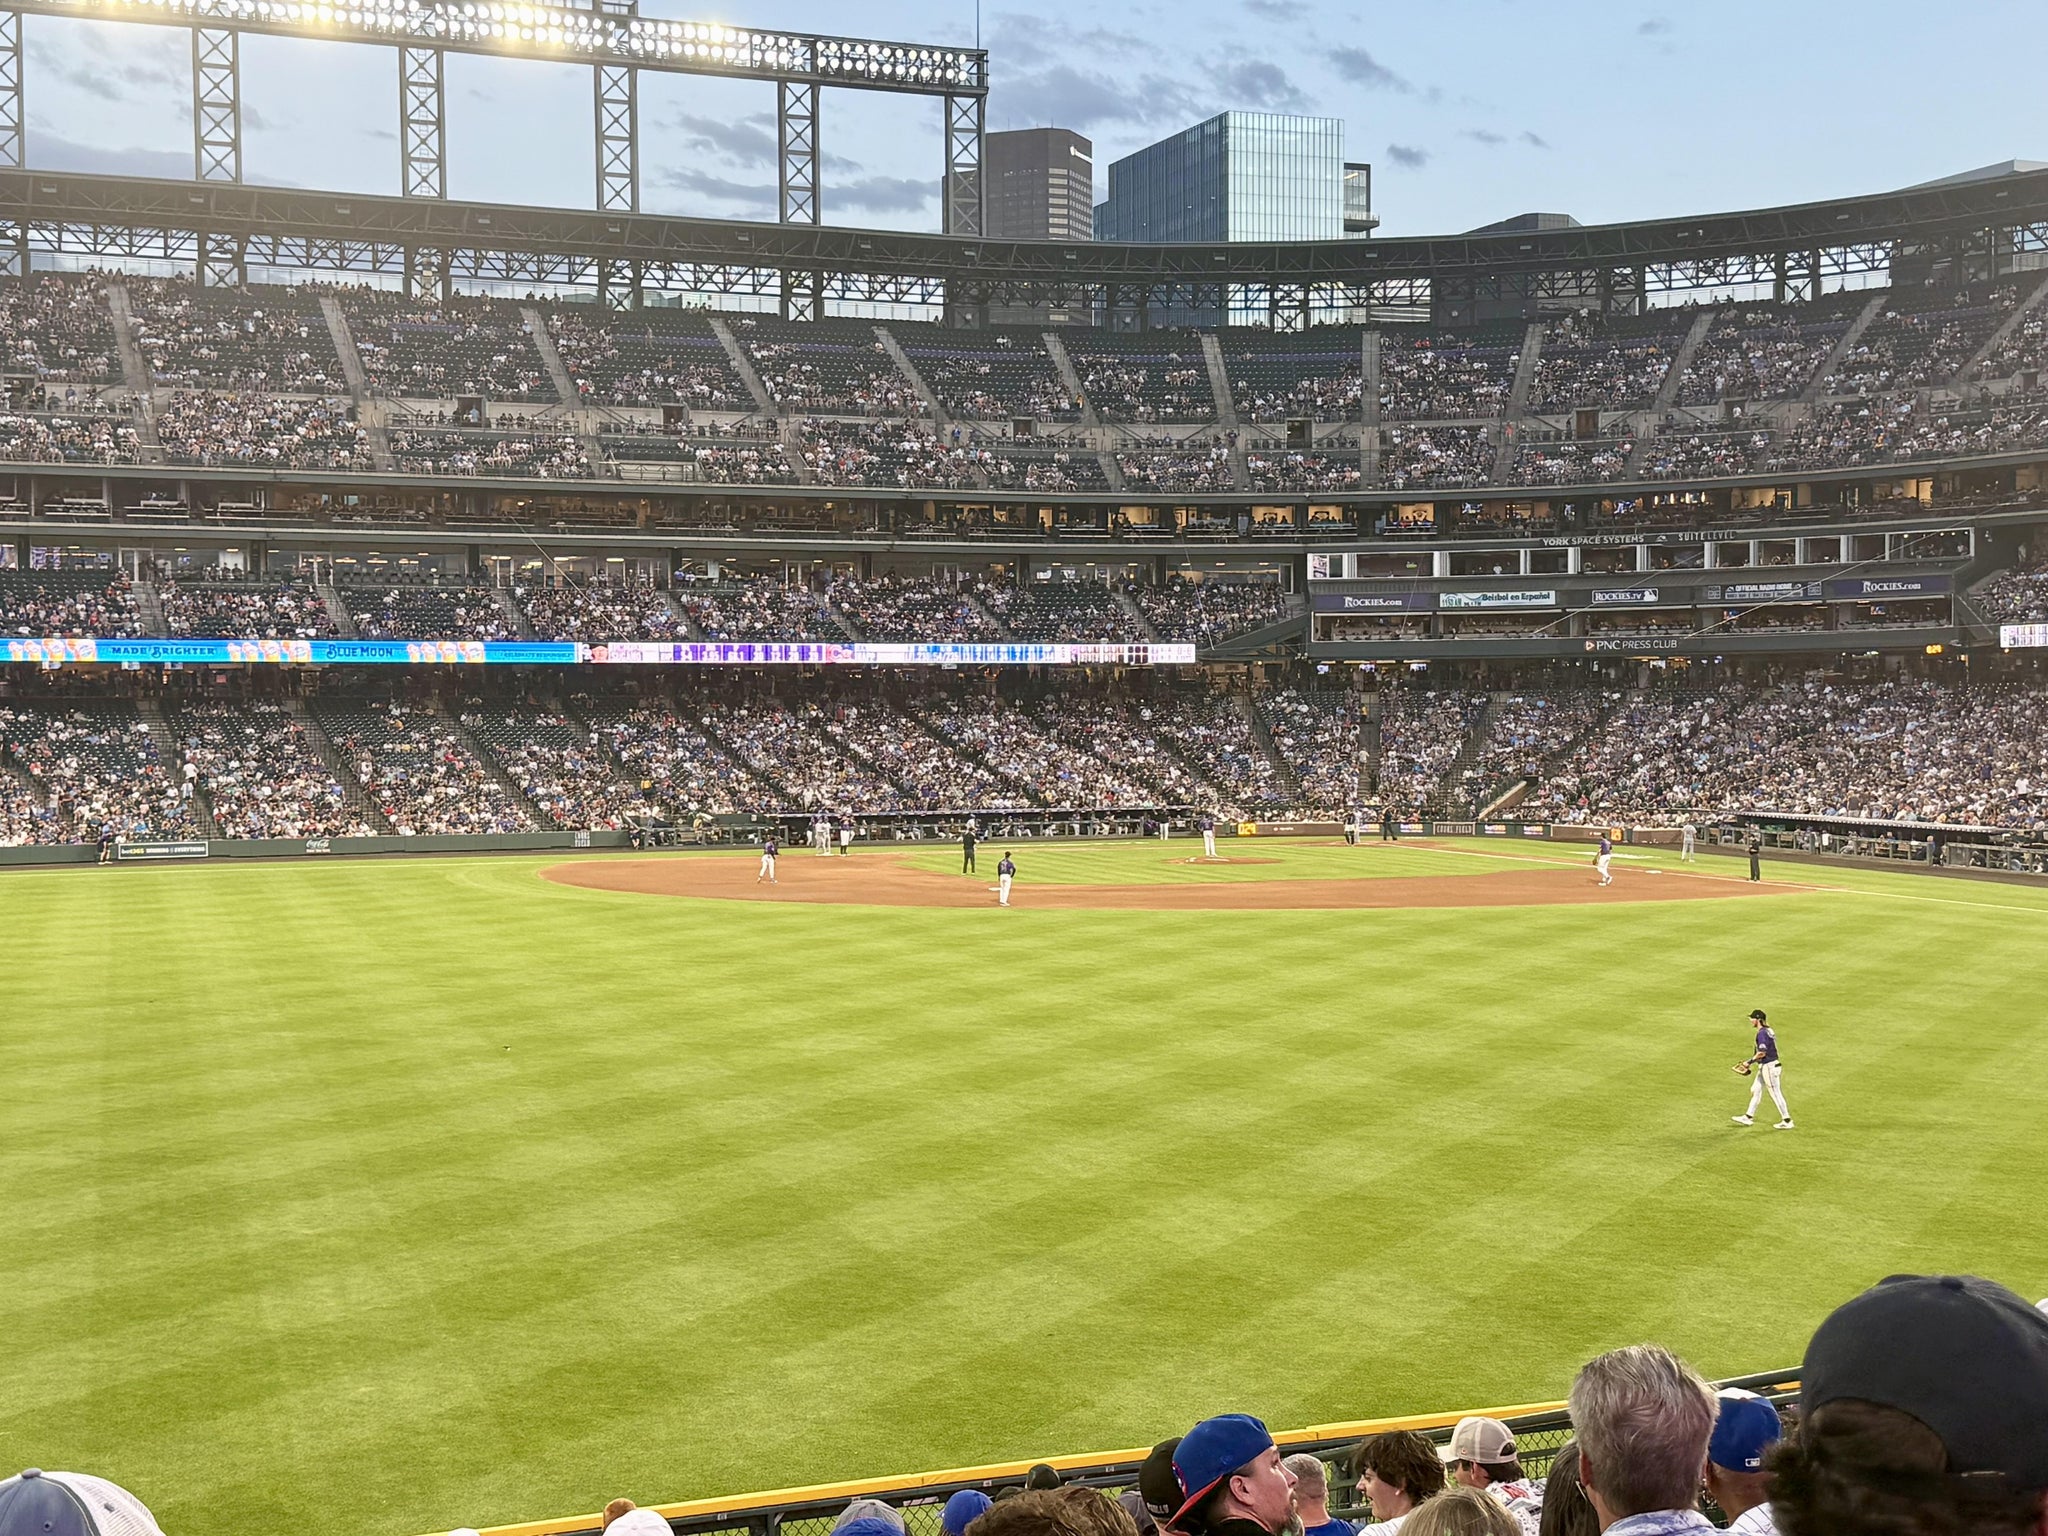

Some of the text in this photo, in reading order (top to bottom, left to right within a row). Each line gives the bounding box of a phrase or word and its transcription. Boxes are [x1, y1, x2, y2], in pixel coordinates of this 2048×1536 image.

[1543, 530, 1736, 547] YORK SPACE SYSTEMS SUITE LEVEL
[1596, 639, 1678, 650] PNC PRESS CLUB
[112, 646, 215, 658] MADE BRIGHTER
[326, 644, 393, 659] BLUE MOON
